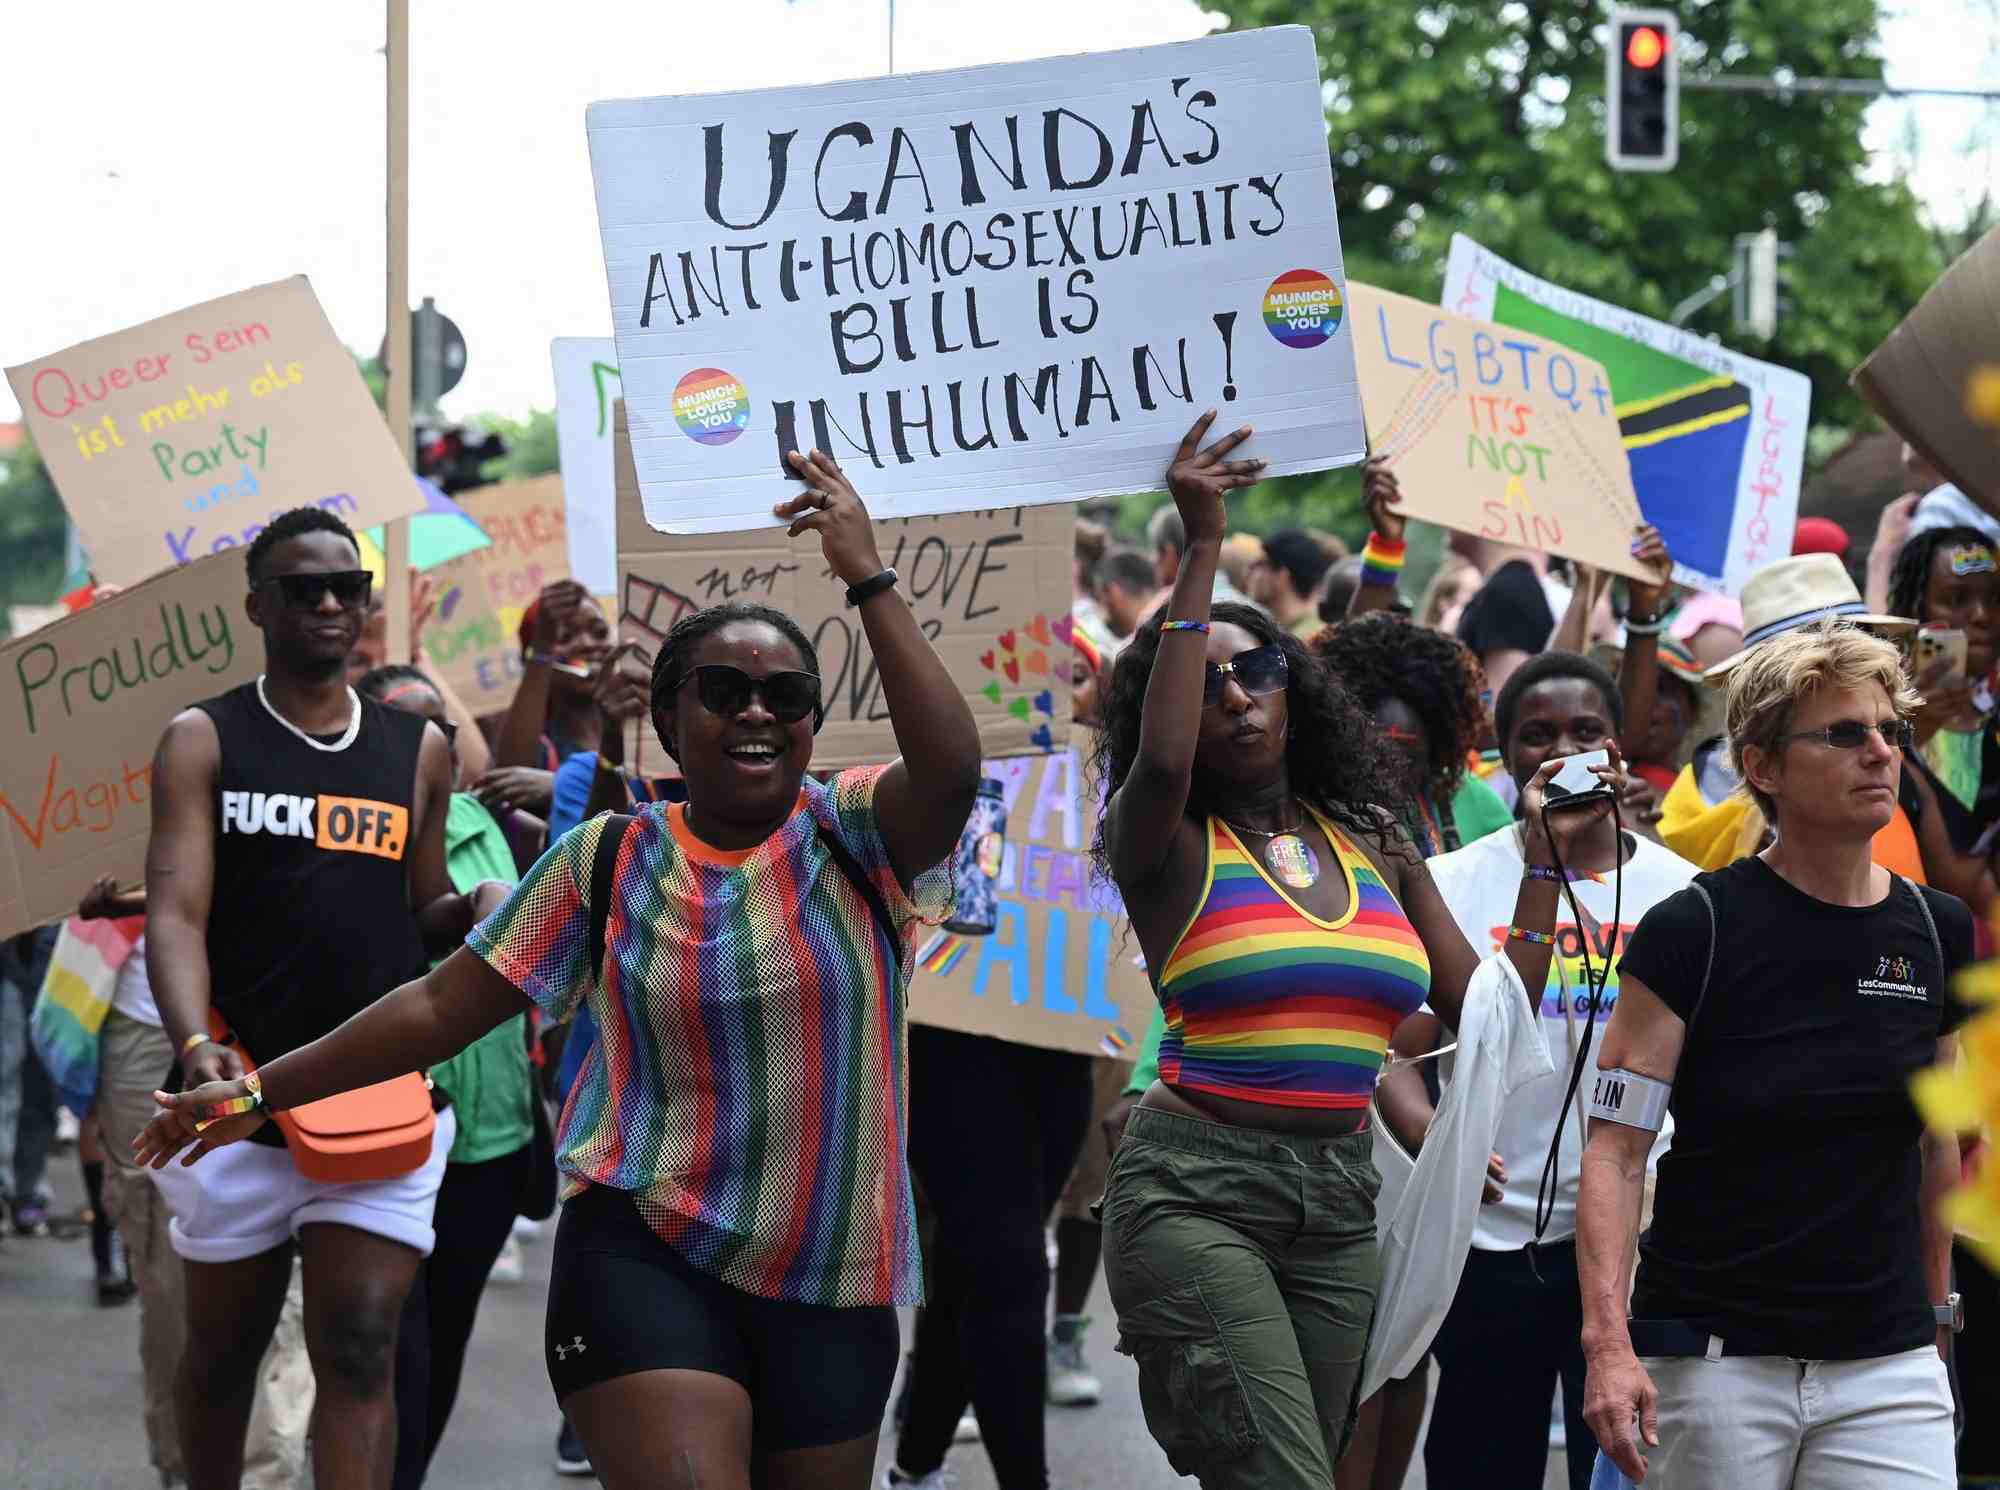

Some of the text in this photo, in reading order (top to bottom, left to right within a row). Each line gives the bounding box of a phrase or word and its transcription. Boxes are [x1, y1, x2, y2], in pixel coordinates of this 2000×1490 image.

[702, 77, 1218, 230] UGANDA'S
[640, 173, 1285, 328] ANTI-HOMOSEXUALITY
[1270, 289, 1334, 305] MUNICH
[1276, 303, 1330, 318] LOVES
[831, 269, 1099, 375] BILL IS
[1287, 316, 1321, 331] YOU
[32, 352, 173, 419] Queer
[677, 383, 737, 409] MUNICH
[687, 399, 737, 420] LOVES
[71, 359, 305, 462] ist mehr als
[699, 410, 733, 429] YOU
[1468, 392, 1534, 437] IT'S
[151, 422, 269, 482] Party
[1466, 432, 1553, 482] NOT
[182, 462, 261, 513] und
[1503, 475, 1534, 512] A
[1480, 499, 1565, 548] SIN
[16, 602, 236, 735] Proudly
[221, 790, 400, 852] FUCK OFF.
[971, 899, 1121, 1021] ALL
[1579, 962, 1606, 986] is
[1858, 978, 1916, 995] LesCommunity
